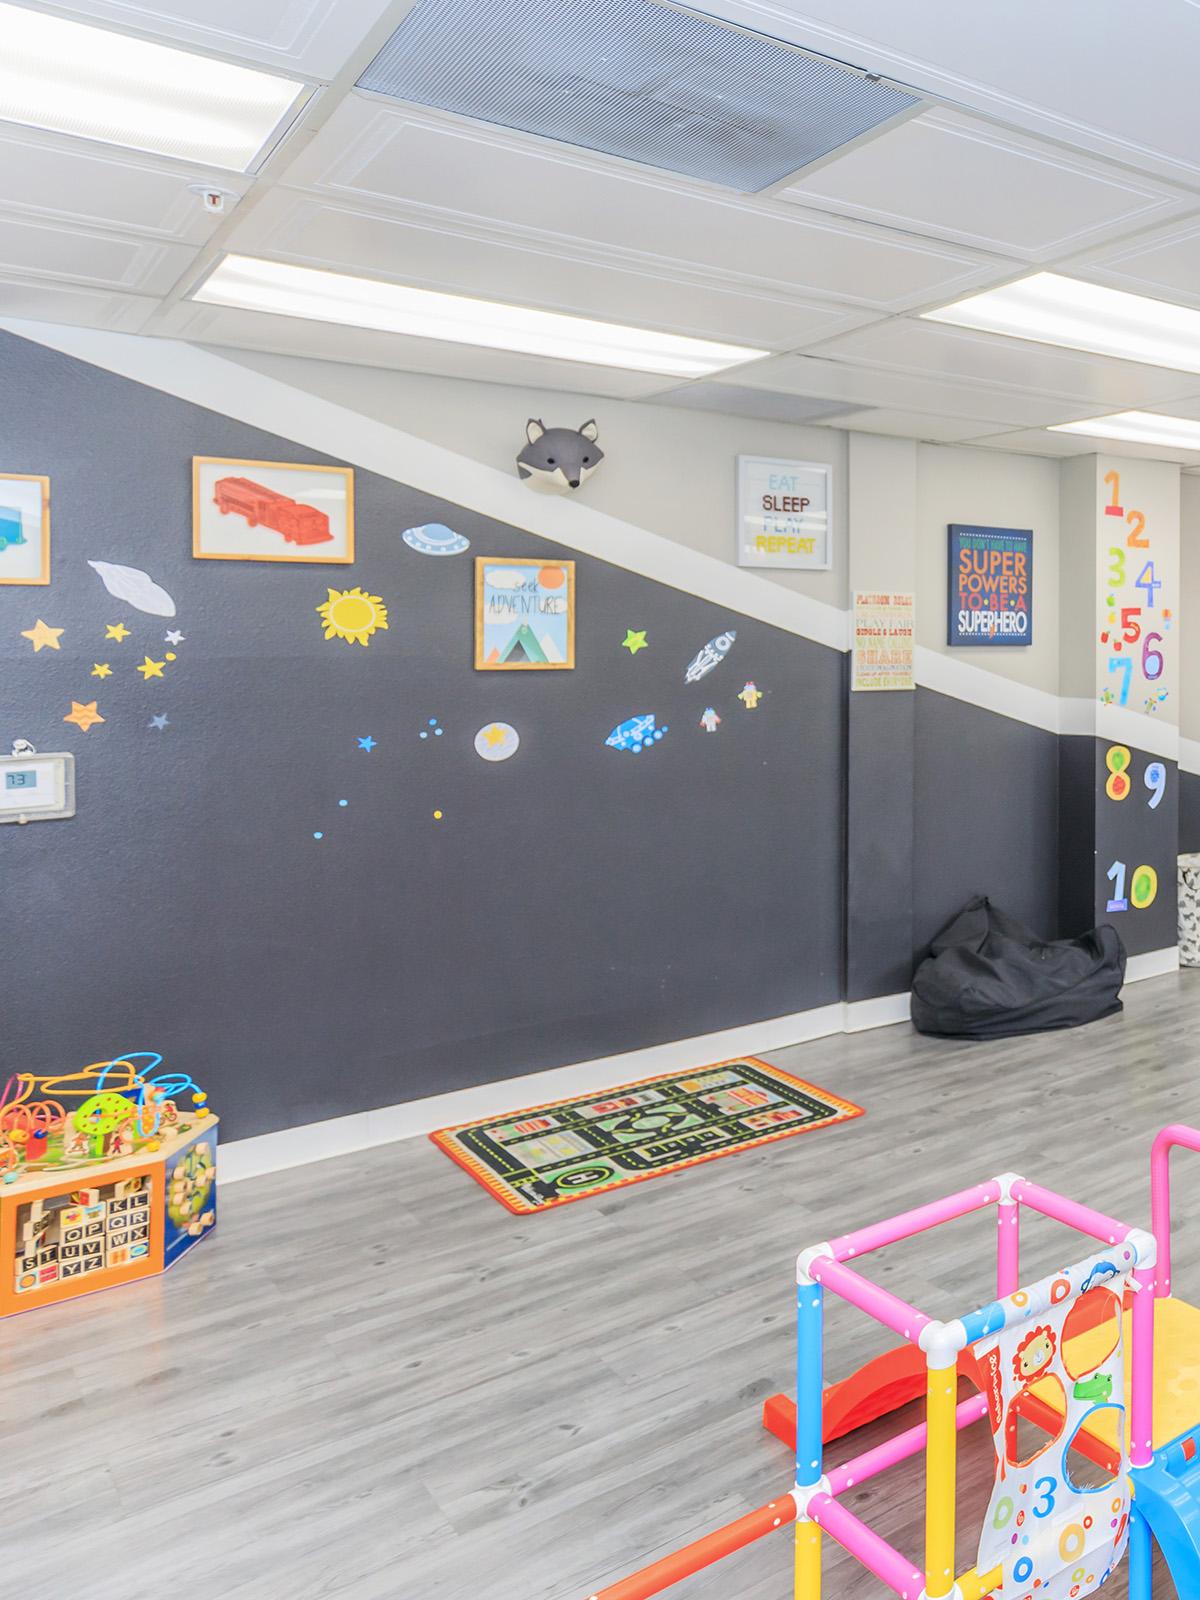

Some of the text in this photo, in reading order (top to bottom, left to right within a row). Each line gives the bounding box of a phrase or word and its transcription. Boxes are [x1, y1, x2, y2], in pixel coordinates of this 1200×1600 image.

[768, 474, 799, 491] EAT
[1104, 470, 1123, 517] 1
[762, 494, 810, 513] SLEEP
[1126, 510, 1150, 549] 2
[756, 535, 816, 554] REPEAT
[959, 548, 1027, 577] SUPER
[1108, 547, 1126, 588] 3
[512, 576, 538, 593] seek
[959, 573, 1027, 595] POWERS
[1135, 561, 1161, 608] 4
[489, 594, 563, 616] ADVENTURE
[958, 610, 1028, 634] SUPERHERO
[1121, 608, 1141, 644] 5
[1141, 632, 1164, 680] 6
[1109, 657, 1133, 707] 7
[7, 773, 26, 786] 73
[1105, 745, 1166, 810] 8 9
[1106, 860, 1158, 912] 10
[113, 1195, 144, 1211] K L
[111, 1212, 144, 1228] Q R
[67, 1225, 99, 1240] O P
[113, 1229, 144, 1246] W X
[25, 1250, 54, 1269] S T
[65, 1244, 96, 1257] U V
[65, 1259, 99, 1275] Y Z
[1032, 1476, 1058, 1518] 3
